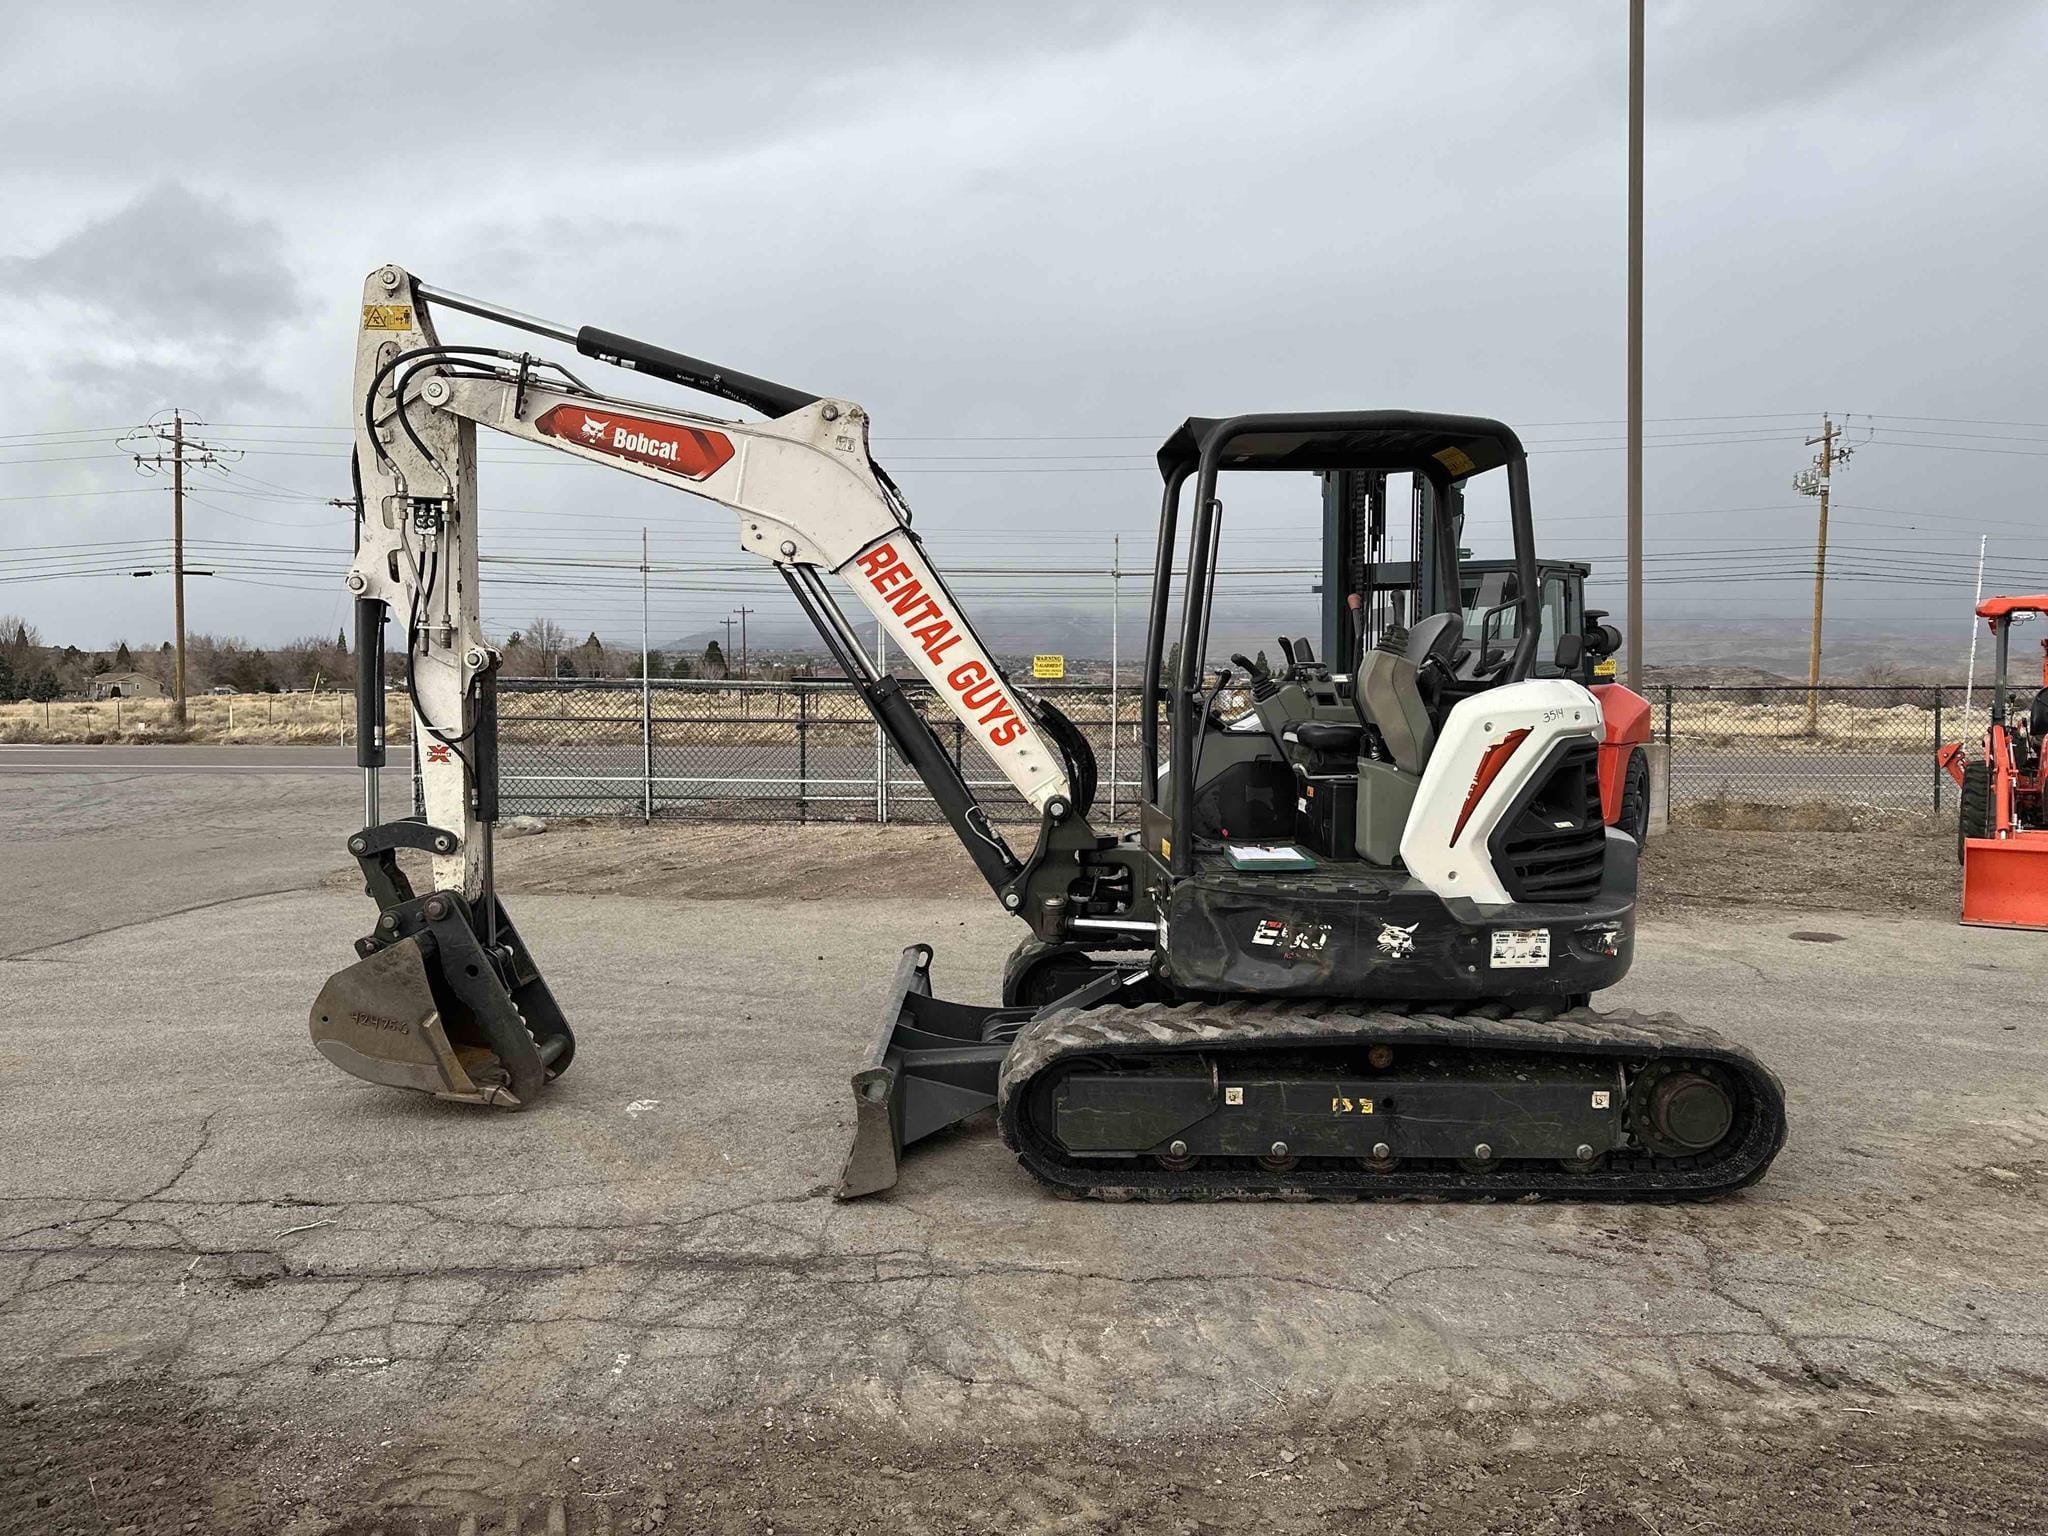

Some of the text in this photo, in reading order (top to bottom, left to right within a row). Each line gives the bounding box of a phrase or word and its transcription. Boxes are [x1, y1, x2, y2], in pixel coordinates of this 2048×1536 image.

[613, 427, 679, 461] Bobcat
[856, 543, 1028, 746] RENTAL GUYS
[1543, 707, 1564, 723] 3514
